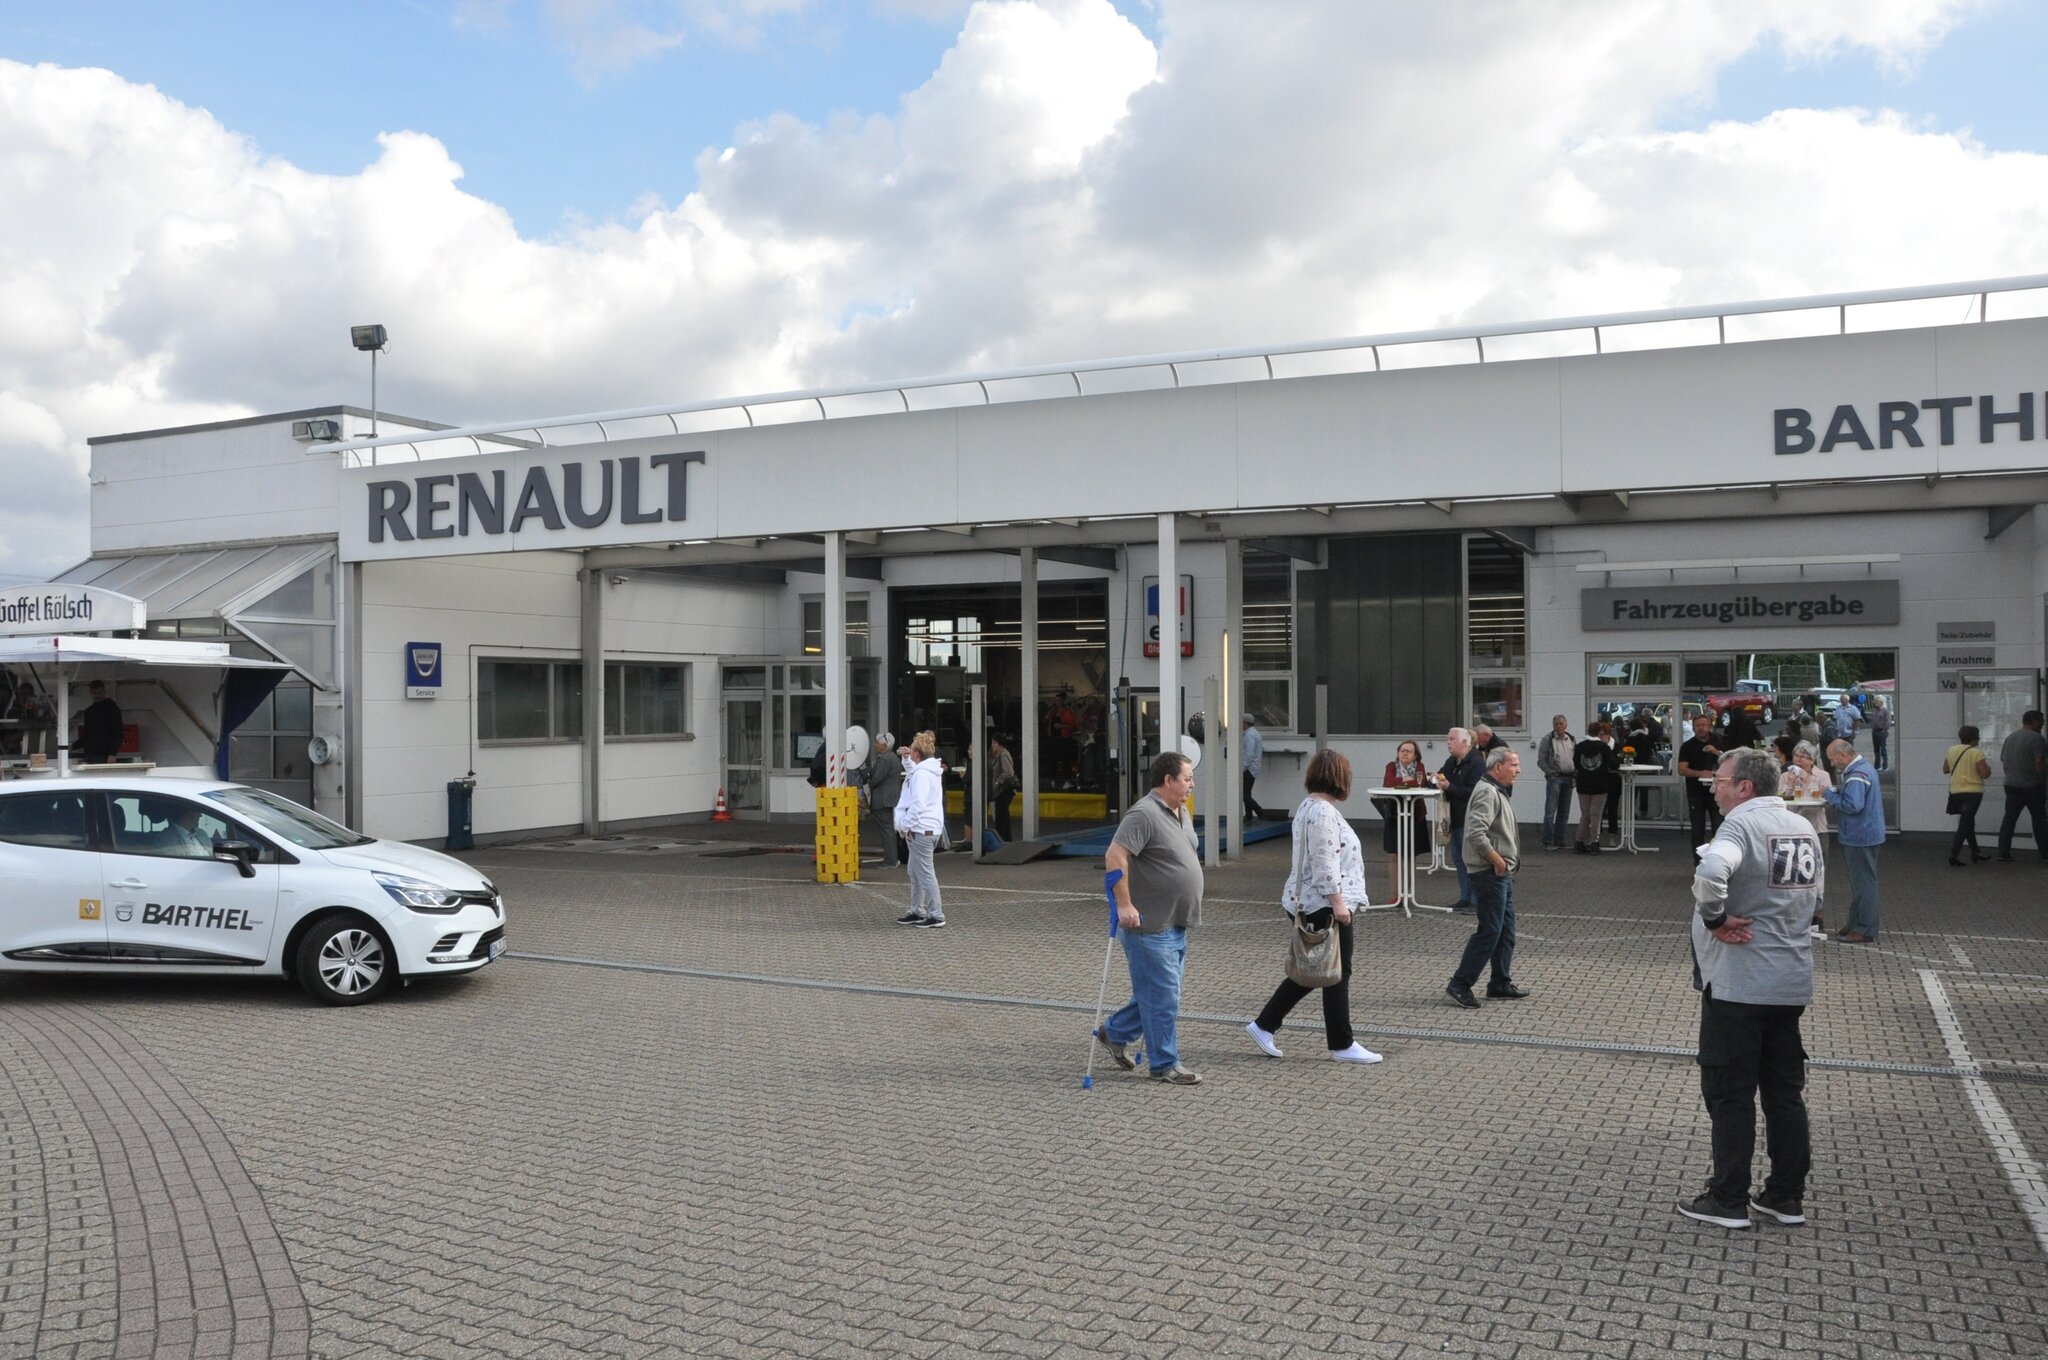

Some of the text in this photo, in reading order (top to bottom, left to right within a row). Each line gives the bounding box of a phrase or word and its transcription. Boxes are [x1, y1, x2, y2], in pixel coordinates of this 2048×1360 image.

[1774, 391, 2048, 455] BARTH
[367, 451, 705, 543] RENAULT
[1612, 594, 1864, 623] Fahrzeugübergabe
[1940, 655, 1993, 665] Annahme
[415, 689, 436, 697] Service
[1778, 842, 1816, 883] 76
[141, 903, 253, 931] BARTHEL
